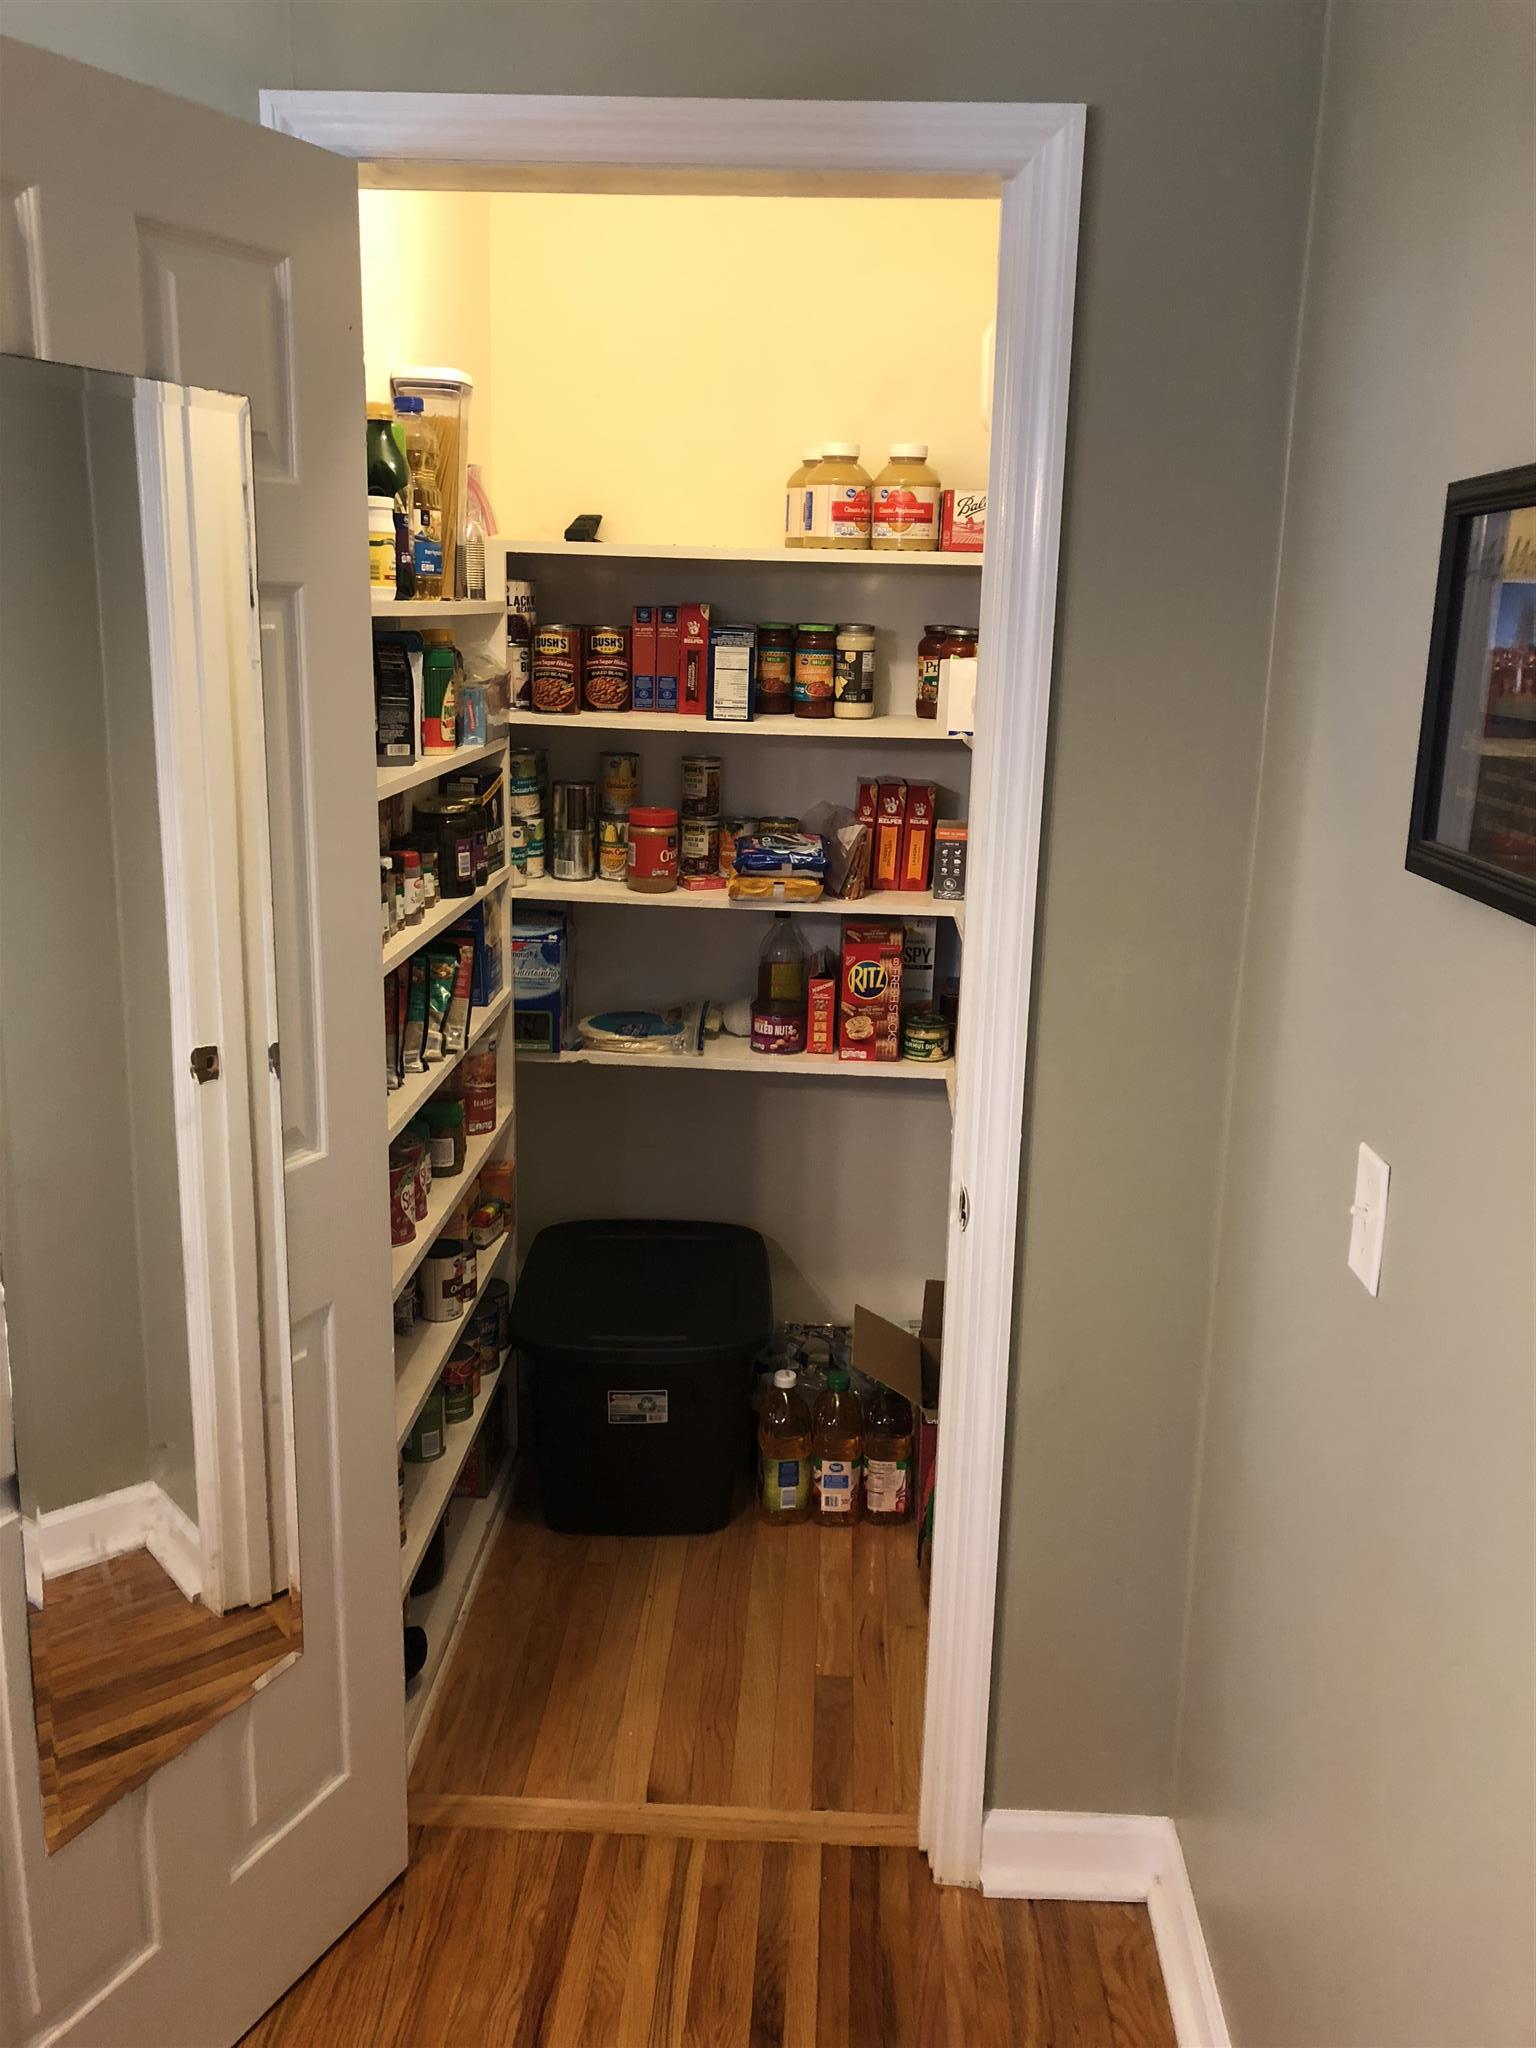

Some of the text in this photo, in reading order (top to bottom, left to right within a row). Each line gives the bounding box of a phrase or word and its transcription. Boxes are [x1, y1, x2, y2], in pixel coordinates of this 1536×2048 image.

[903, 947, 931, 963] SPY
[850, 966, 885, 994] RITZ
[754, 1018, 795, 1036] MIXED NUTS
[887, 1004, 899, 1042] STACKS
